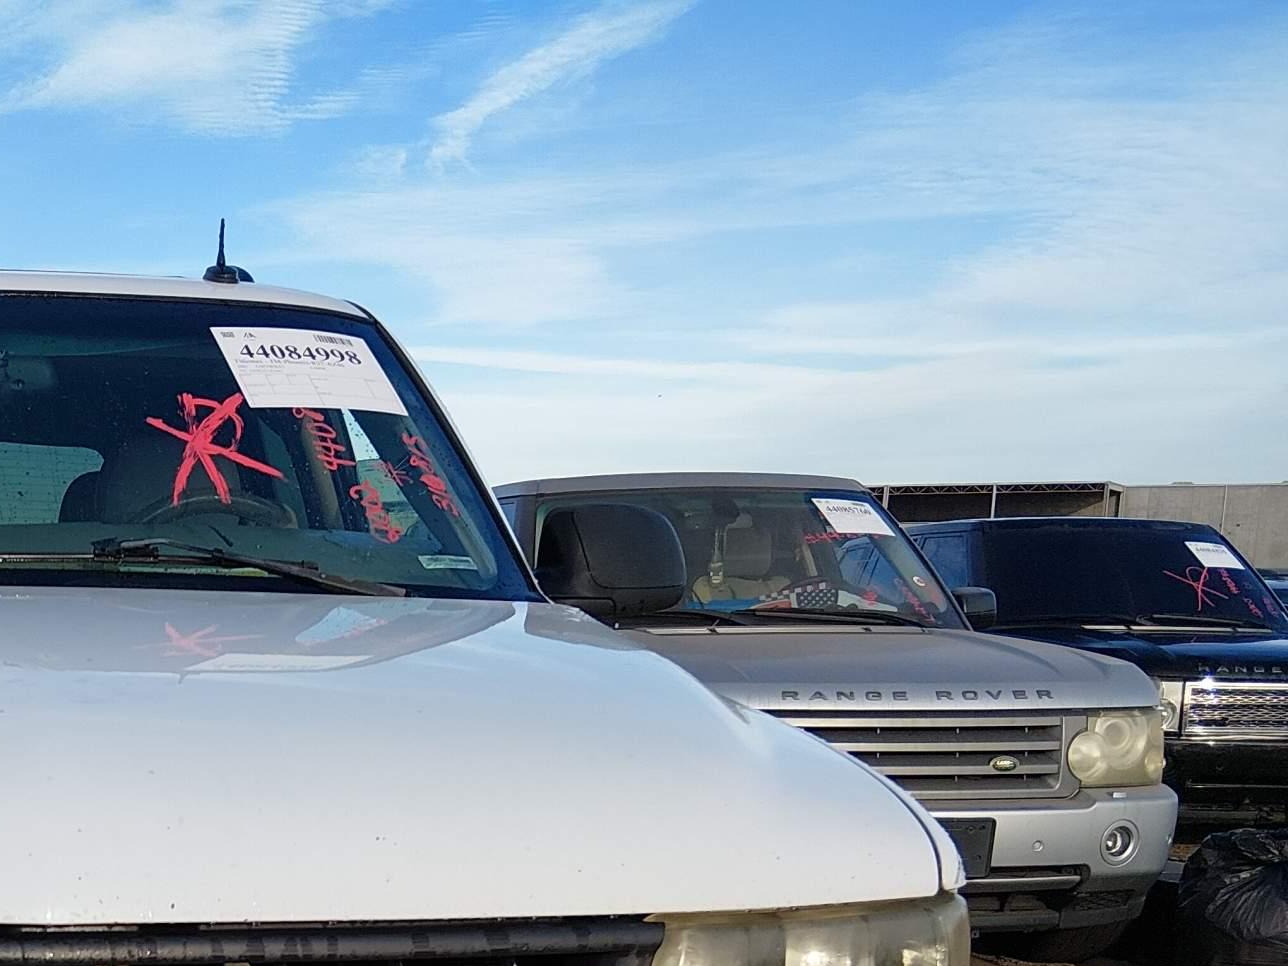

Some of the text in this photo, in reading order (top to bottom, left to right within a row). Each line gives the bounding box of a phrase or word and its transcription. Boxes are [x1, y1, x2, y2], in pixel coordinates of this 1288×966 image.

[239, 343, 362, 366] 44084998
[781, 689, 1054, 701] RANGE ROVER
